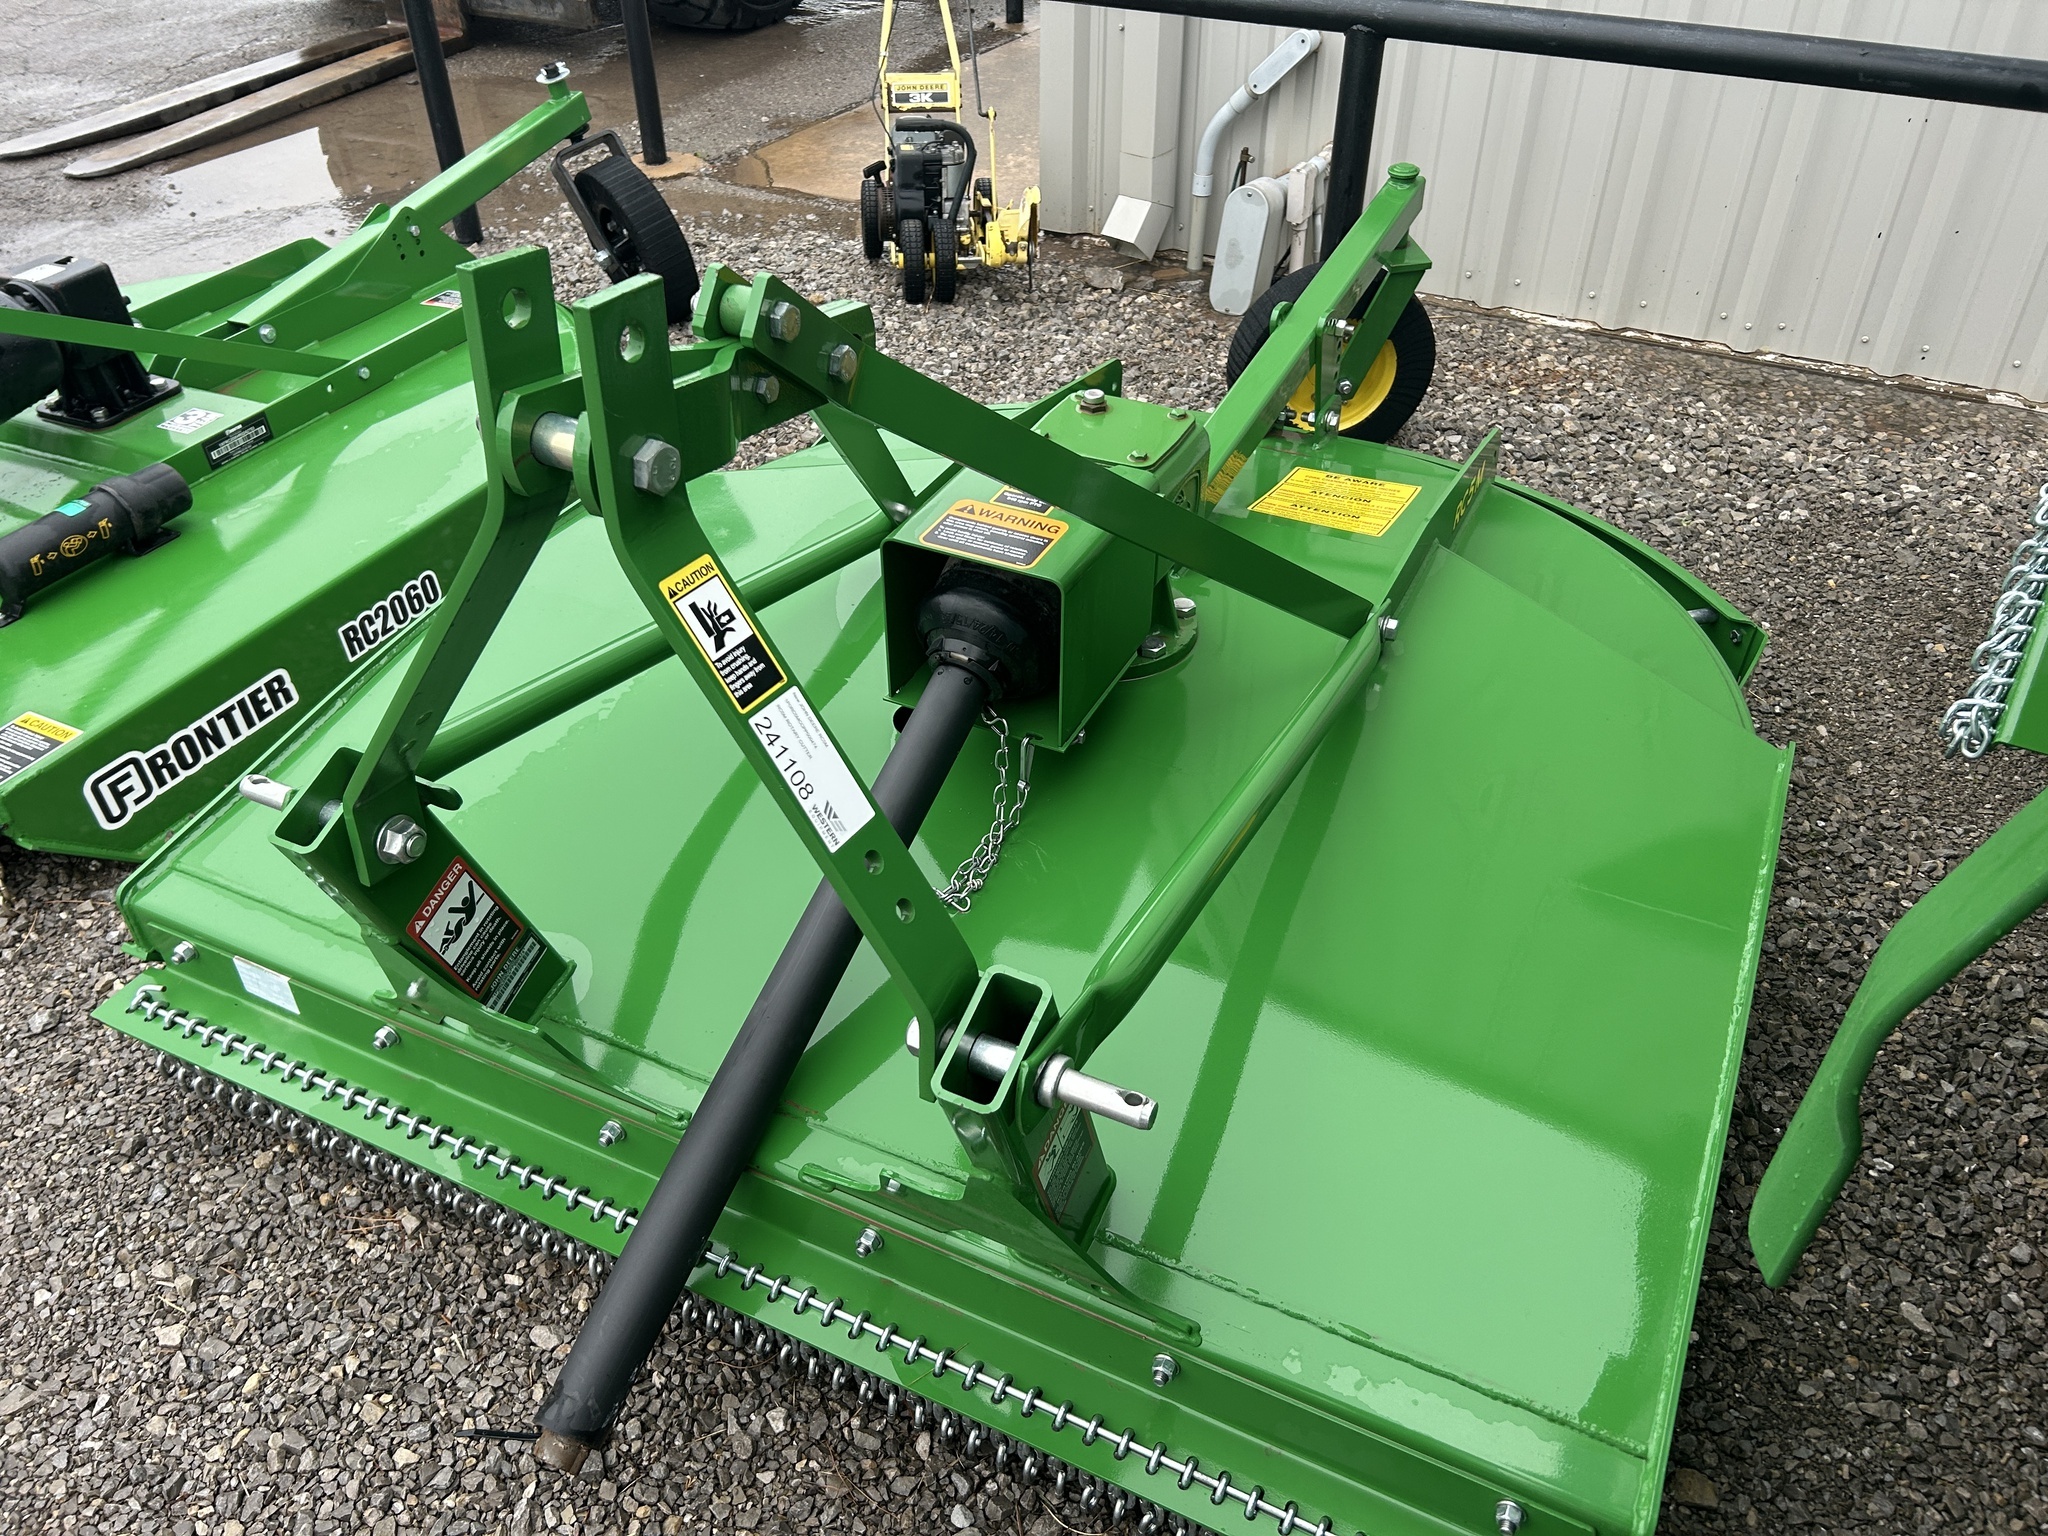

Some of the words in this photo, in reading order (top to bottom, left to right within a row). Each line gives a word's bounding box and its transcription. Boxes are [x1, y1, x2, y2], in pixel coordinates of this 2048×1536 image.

[908, 93, 934, 103] 3K
[919, 83, 945, 91] DEERE
[1344, 477, 1386, 486] AWARE
[977, 508, 1061, 534] WARNING
[1290, 503, 1360, 519] ATTENTION
[674, 562, 714, 592] CAUTION
[342, 573, 440, 659] RC2060
[28, 718, 73, 741] CAUTION
[91, 673, 295, 824] FRONTIER
[755, 715, 814, 800] 241108
[808, 809, 834, 849] EQUIPMENT
[811, 803, 839, 846] WESTERN
[422, 862, 462, 917] DANGER
[453, 932, 480, 971] Entanglement
[483, 905, 498, 927] rotating
[456, 949, 473, 973] driveline
[472, 938, 480, 950] can
[480, 921, 492, 939] cause
[460, 955, 474, 976] serious
[473, 940, 485, 956] injury
[488, 915, 501, 933] death.
[466, 967, 477, 982] Keep
[480, 940, 494, 960] shields
[497, 917, 509, 935] place.
[471, 971, 483, 988] Avoid
[482, 950, 497, 971] contact
[496, 937, 505, 950] with
[474, 968, 490, 991] rotating
[489, 952, 501, 969] parts.
[489, 970, 504, 990] JOHN
[503, 946, 520, 970] DEERE
[1042, 1101, 1068, 1151] DANG
